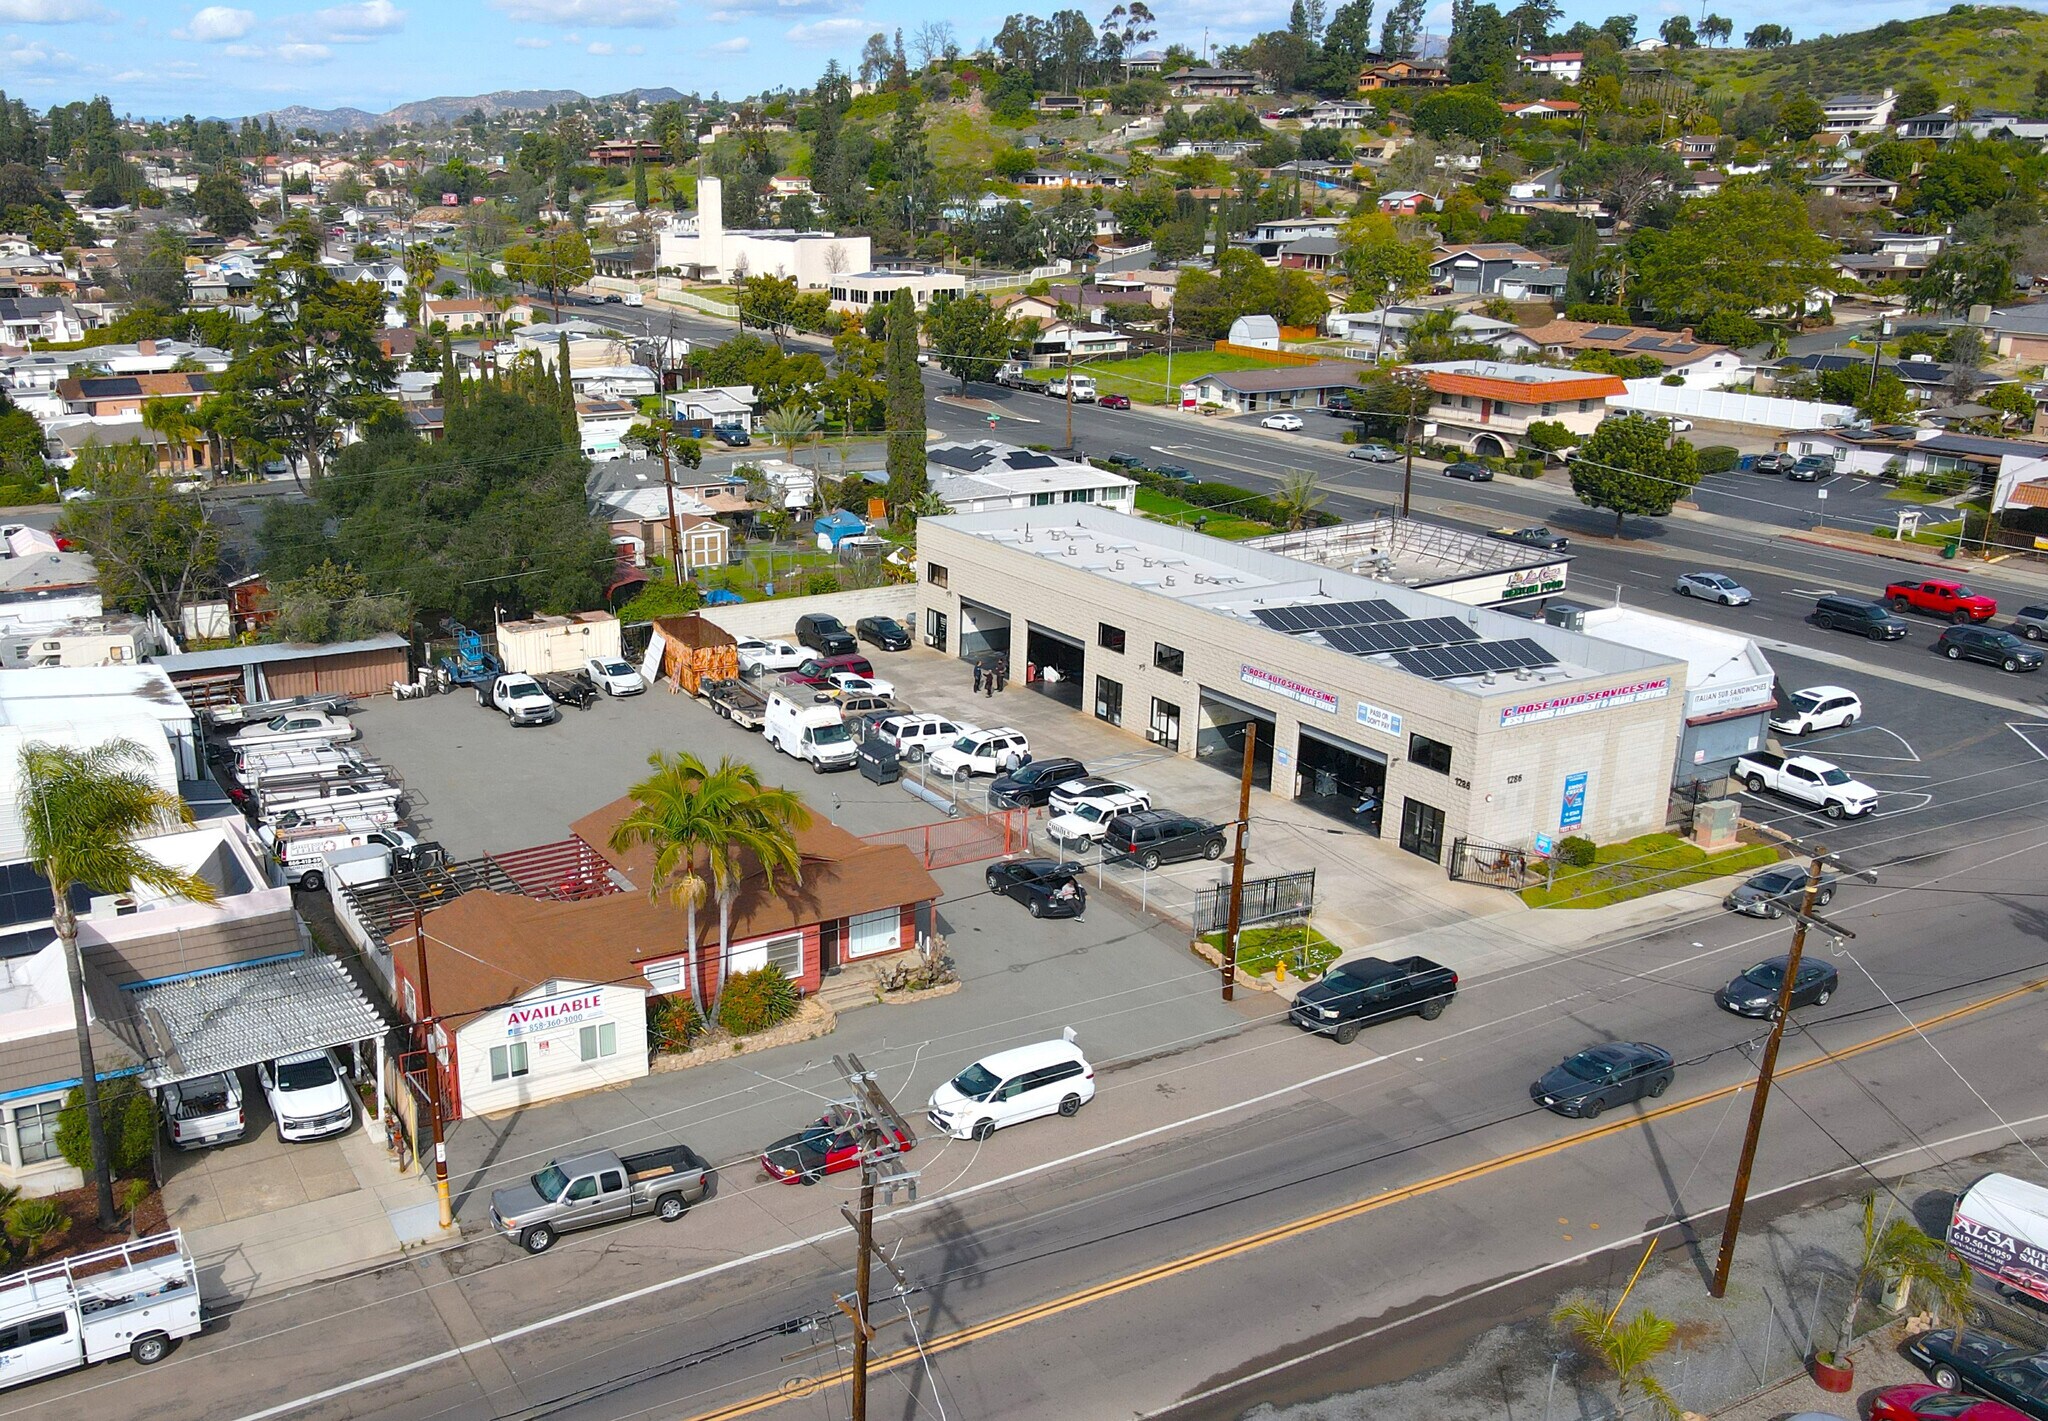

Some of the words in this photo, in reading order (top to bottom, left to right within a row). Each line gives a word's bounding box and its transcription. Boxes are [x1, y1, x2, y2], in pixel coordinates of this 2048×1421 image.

[1249, 668, 1267, 680] ROSE
[1268, 674, 1287, 686] AUTO
[1286, 680, 1322, 699] SERVICES
[1695, 692, 1717, 702] ITALIAN
[1718, 689, 1729, 699] SUB
[1729, 683, 1767, 697] SANDWICHES
[1517, 702, 1550, 714] ROSE
[1551, 695, 1585, 708] AUTO
[1586, 683, 1644, 701] SERVICES
[1555, 701, 1601, 717] ALIGNMENT
[1601, 699, 1609, 708] &
[1608, 693, 1636, 706] BRAKE
[1635, 688, 1669, 702] SERVICE
[1367, 716, 1380, 727] DON'T
[1380, 721, 1390, 730] PAY
[1370, 709, 1382, 718] PASS
[1381, 712, 1389, 720] OR
[1455, 777, 1471, 790] 1286
[1507, 774, 1523, 784] 1286
[508, 995, 601, 1026] AVAILABLE
[529, 1013, 583, 1033] 858-360-3000
[1952, 1213, 2017, 1254] ALSA
[1953, 1232, 2012, 1262] 619.504.9959
[2023, 1246, 2048, 1262] AUT
